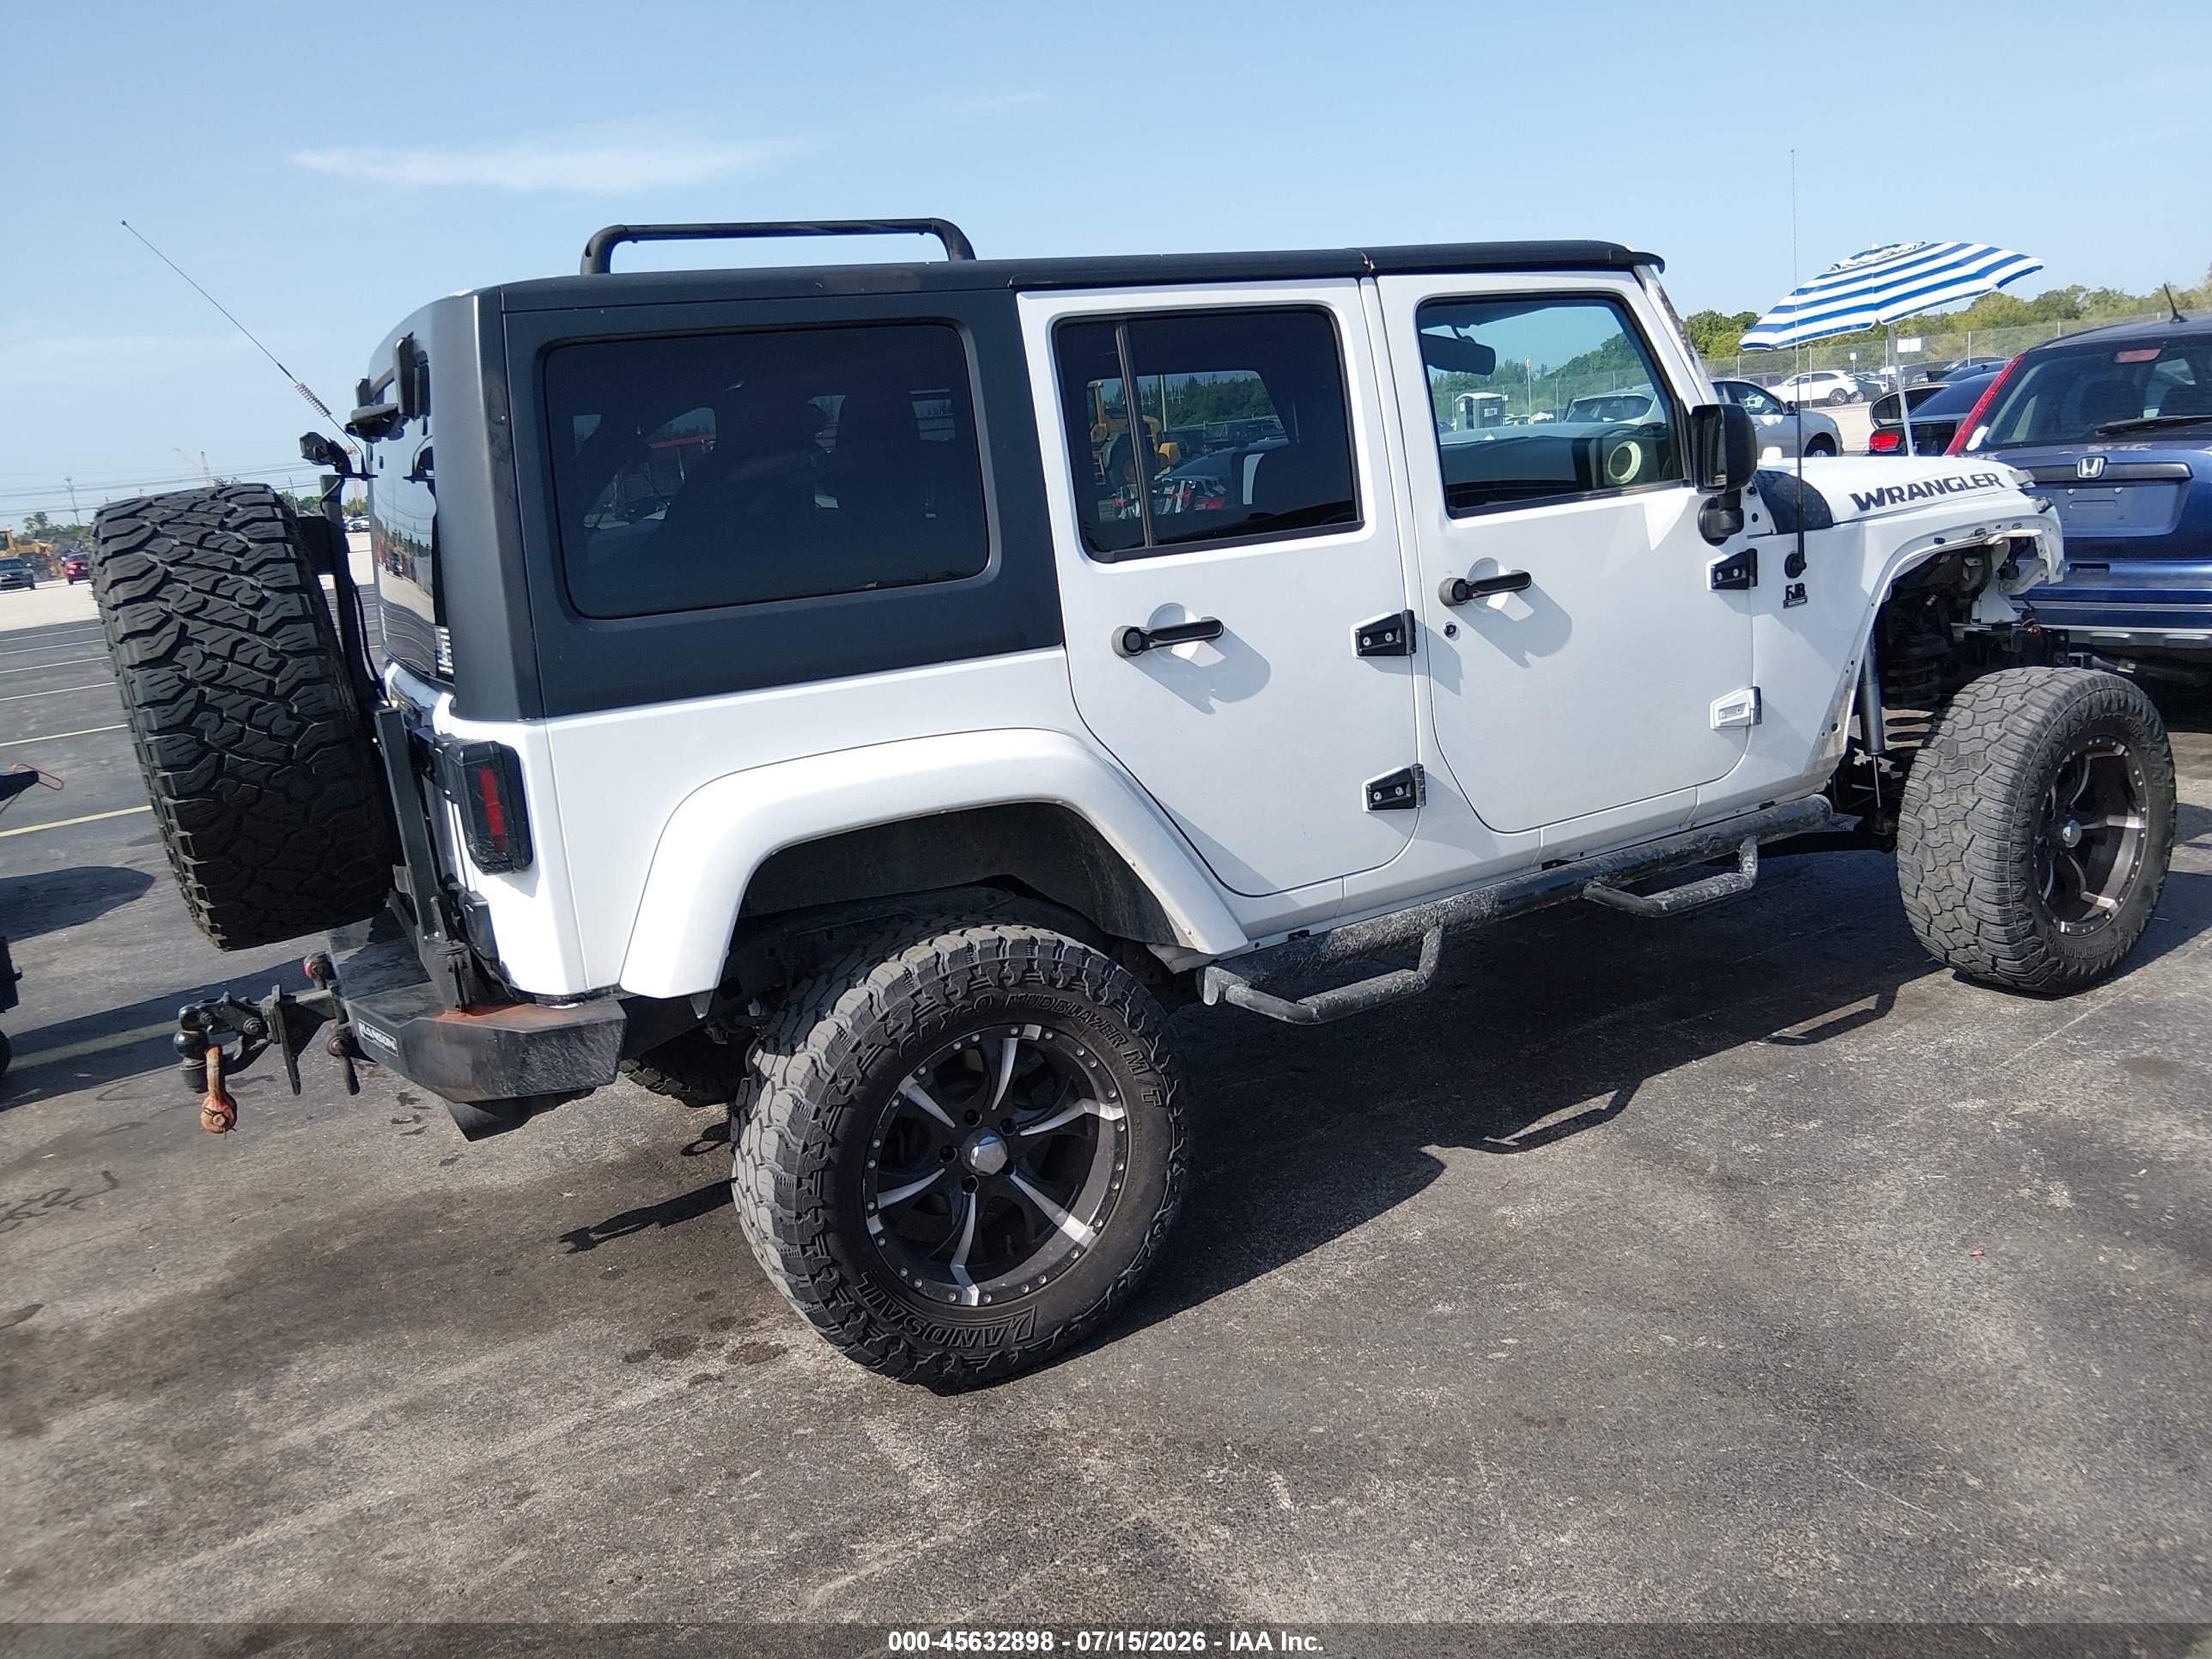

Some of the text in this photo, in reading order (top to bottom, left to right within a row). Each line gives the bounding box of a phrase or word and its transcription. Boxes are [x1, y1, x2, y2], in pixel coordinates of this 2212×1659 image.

[1849, 471, 2006, 512] WRANGLER
[1004, 993, 1128, 1048] MUDBLAZER
[1120, 1048, 1162, 1107] M/T
[854, 1270, 1039, 1349] LANDSAIL
